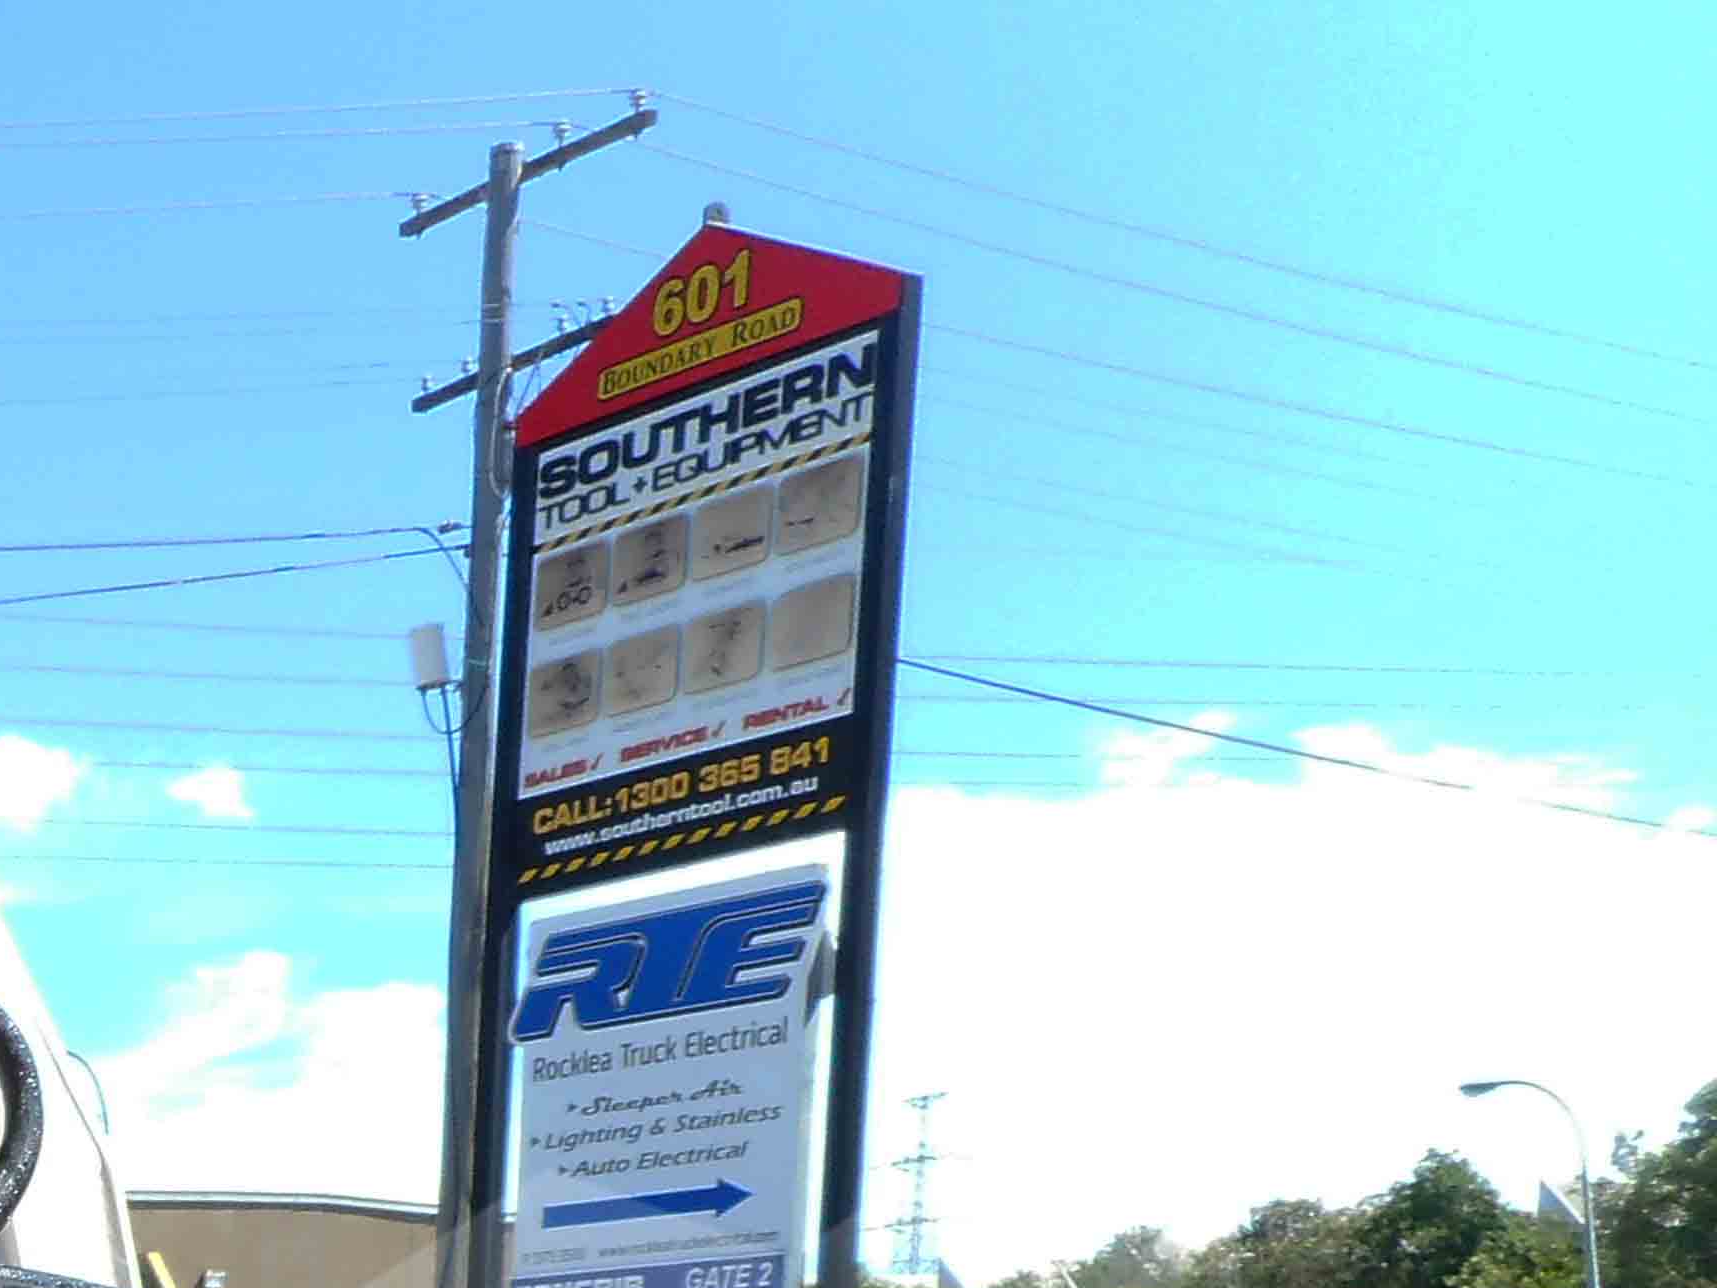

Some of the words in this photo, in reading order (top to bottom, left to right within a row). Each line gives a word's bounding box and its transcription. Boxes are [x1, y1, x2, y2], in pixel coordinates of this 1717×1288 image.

[653, 249, 752, 336] 601
[540, 343, 878, 499] SOUTHERN
[620, 727, 710, 763] SERVICE
[744, 696, 830, 730] RENTAL
[698, 753, 763, 793] 365
[769, 736, 831, 775] 841
[544, 776, 819, 856] www.southerntool.com.au
[509, 880, 827, 1044] RTE
[532, 1051, 613, 1082] Rocklea
[621, 1040, 678, 1067] Truck
[685, 1016, 789, 1058] Electrical
[544, 1121, 643, 1153] Lighting
[649, 1118, 666, 1136] &
[673, 1103, 783, 1132] Stainless
[568, 1157, 630, 1178] Auto
[636, 1140, 750, 1169] Electrical
[758, 1261, 774, 1287] 2
